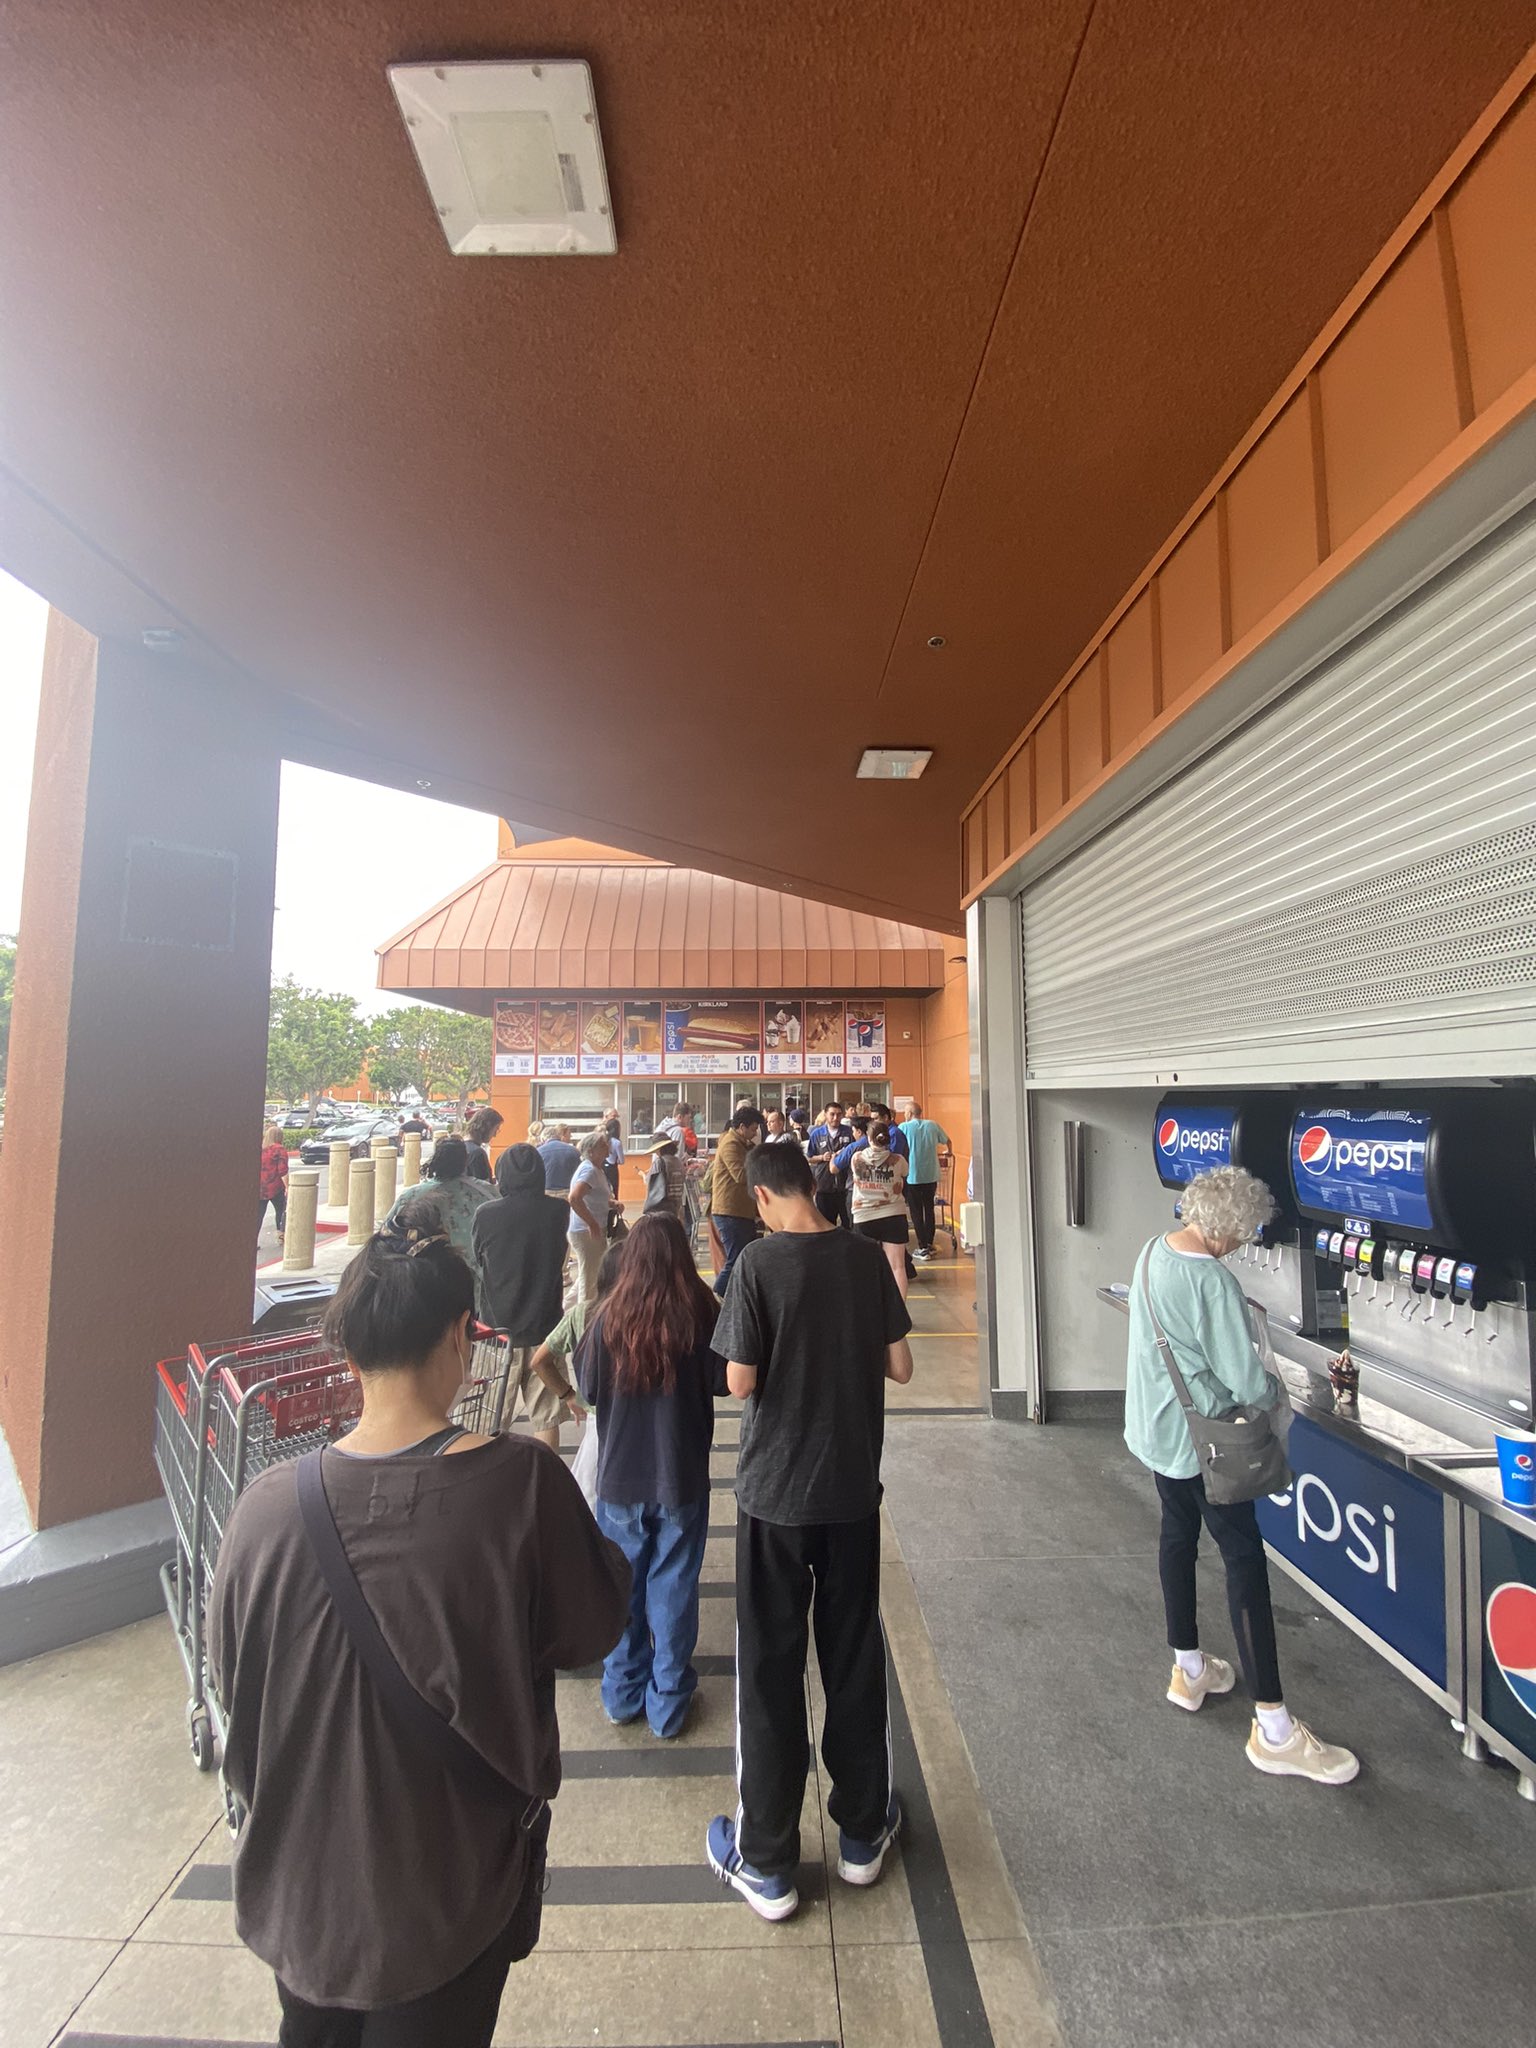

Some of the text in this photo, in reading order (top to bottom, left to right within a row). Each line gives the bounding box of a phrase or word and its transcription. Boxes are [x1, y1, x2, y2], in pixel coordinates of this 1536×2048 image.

[667, 1021, 676, 1051] pepsi
[558, 1056, 576, 1070] 3.99
[735, 1055, 757, 1072] 1.50
[826, 1055, 842, 1068] 1.49
[869, 1055, 882, 1068] .69
[1180, 1127, 1225, 1156] pepsi
[1335, 1138, 1413, 1176] pepsi
[288, 1413, 319, 1427] COSTCO
[1511, 1472, 1536, 1482] peps
[1267, 1472, 1397, 1593] psi
